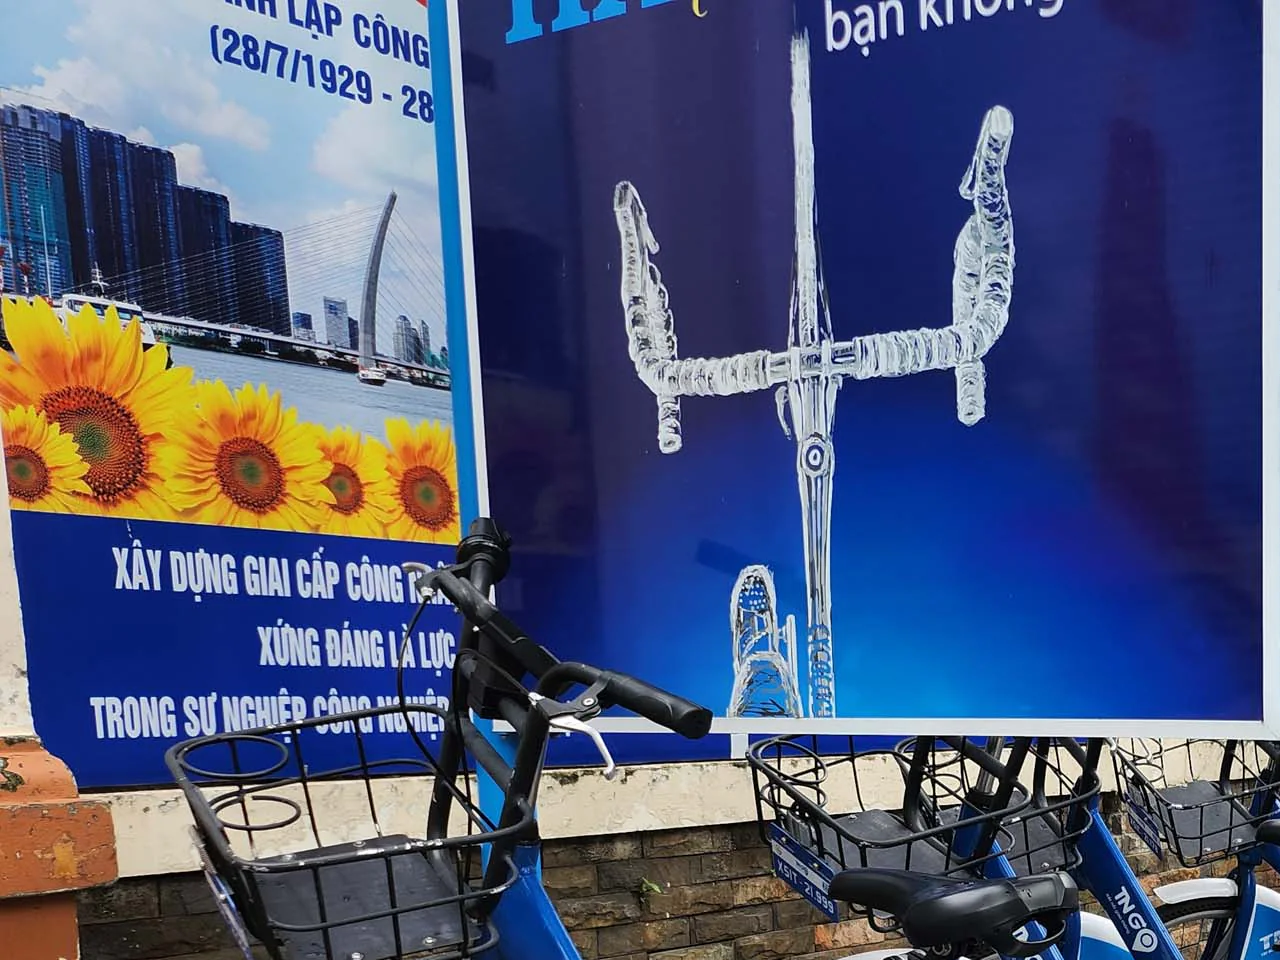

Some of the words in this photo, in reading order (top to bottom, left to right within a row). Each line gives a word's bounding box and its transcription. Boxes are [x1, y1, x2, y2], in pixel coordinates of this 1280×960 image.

[210, 25, 372, 104] (28/7/1929
[353, 14, 430, 69] CÔNG
[112, 539, 161, 590] XÂY
[170, 549, 238, 602] DỰNG
[244, 556, 291, 597] GIAI
[296, 547, 340, 599] CẤP
[346, 556, 404, 603] CÔNG
[257, 618, 321, 666] XỨNG
[325, 621, 385, 668] ĐÁNG
[389, 624, 416, 669] LÀ
[419, 630, 456, 676] LỰC
[90, 696, 177, 738] TRONG
[222, 687, 307, 743] NGHIỆP
[313, 687, 373, 734] CÔNG
[1115, 886, 1158, 953] TNGO
